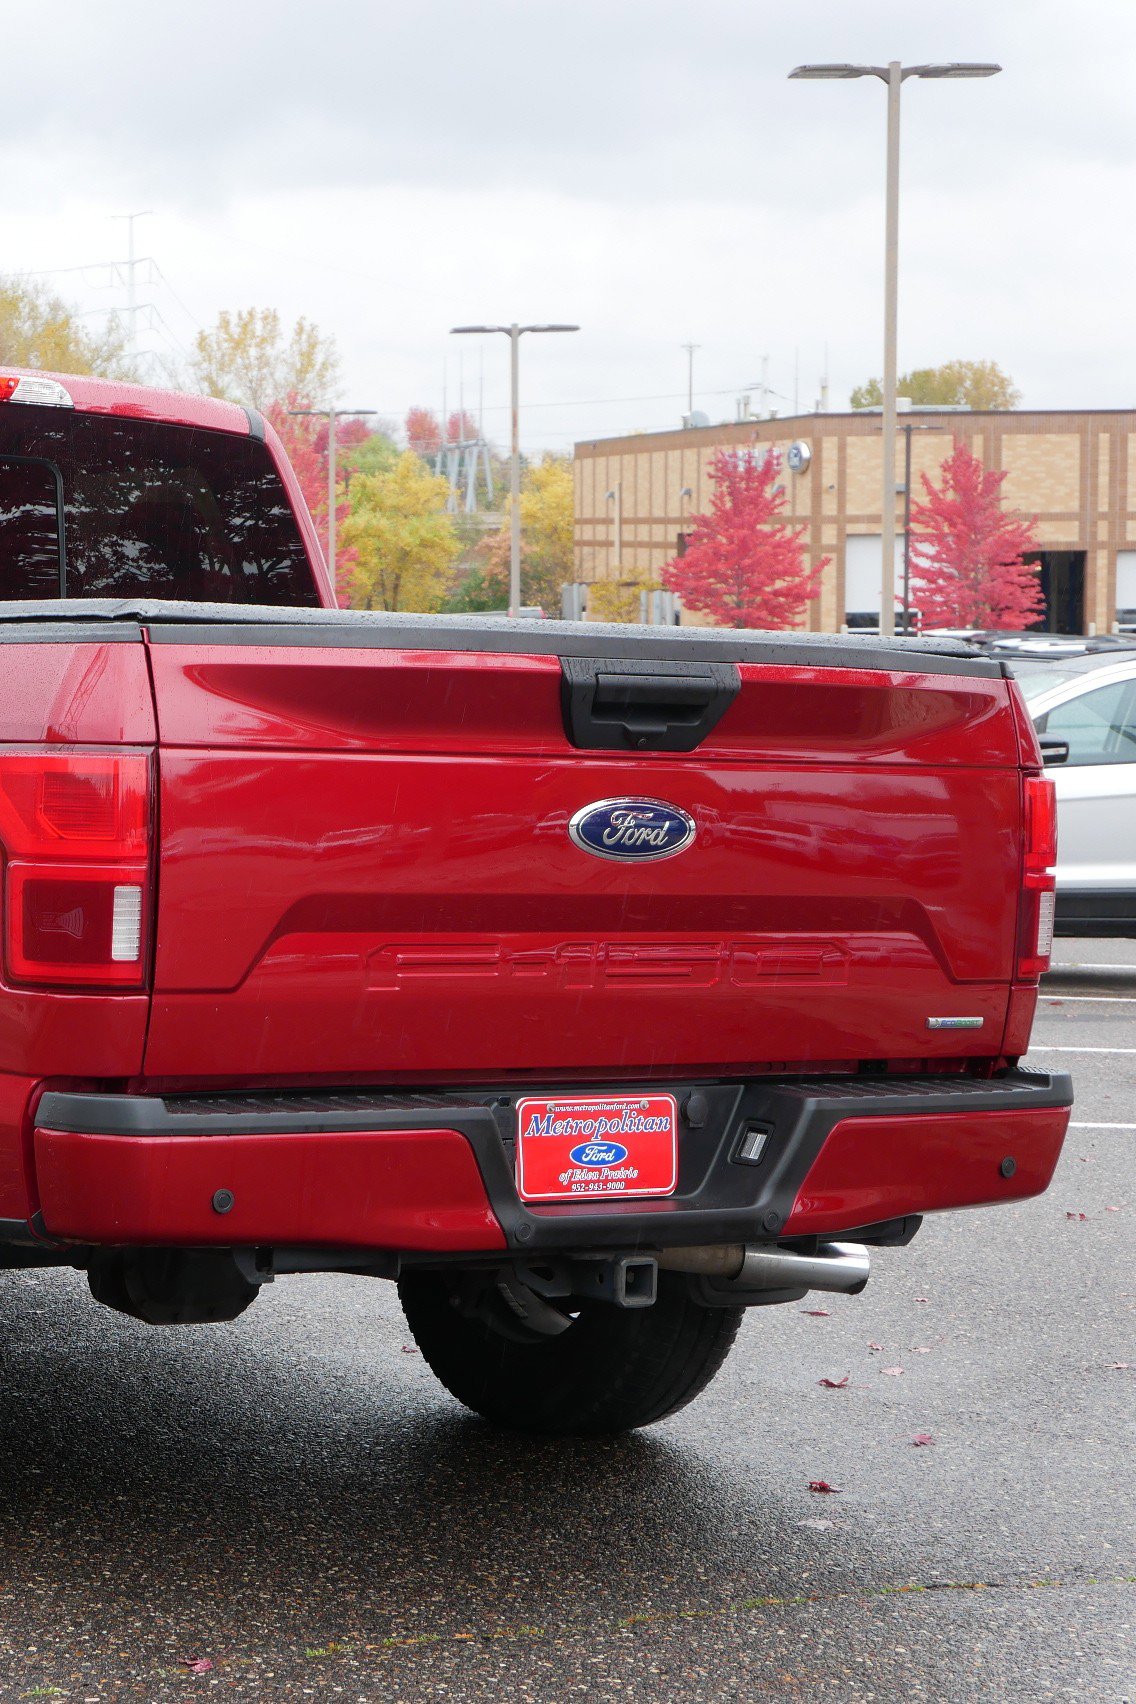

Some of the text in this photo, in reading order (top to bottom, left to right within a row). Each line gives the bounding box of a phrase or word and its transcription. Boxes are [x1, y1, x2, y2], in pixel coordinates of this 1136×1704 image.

[602, 810, 670, 847] Ford
[524, 1110, 670, 1141] Metropolitan
[581, 1145, 616, 1162] Ford
[558, 1166, 639, 1185] of Eden Prairie
[571, 1181, 625, 1192] 952-943-9000
